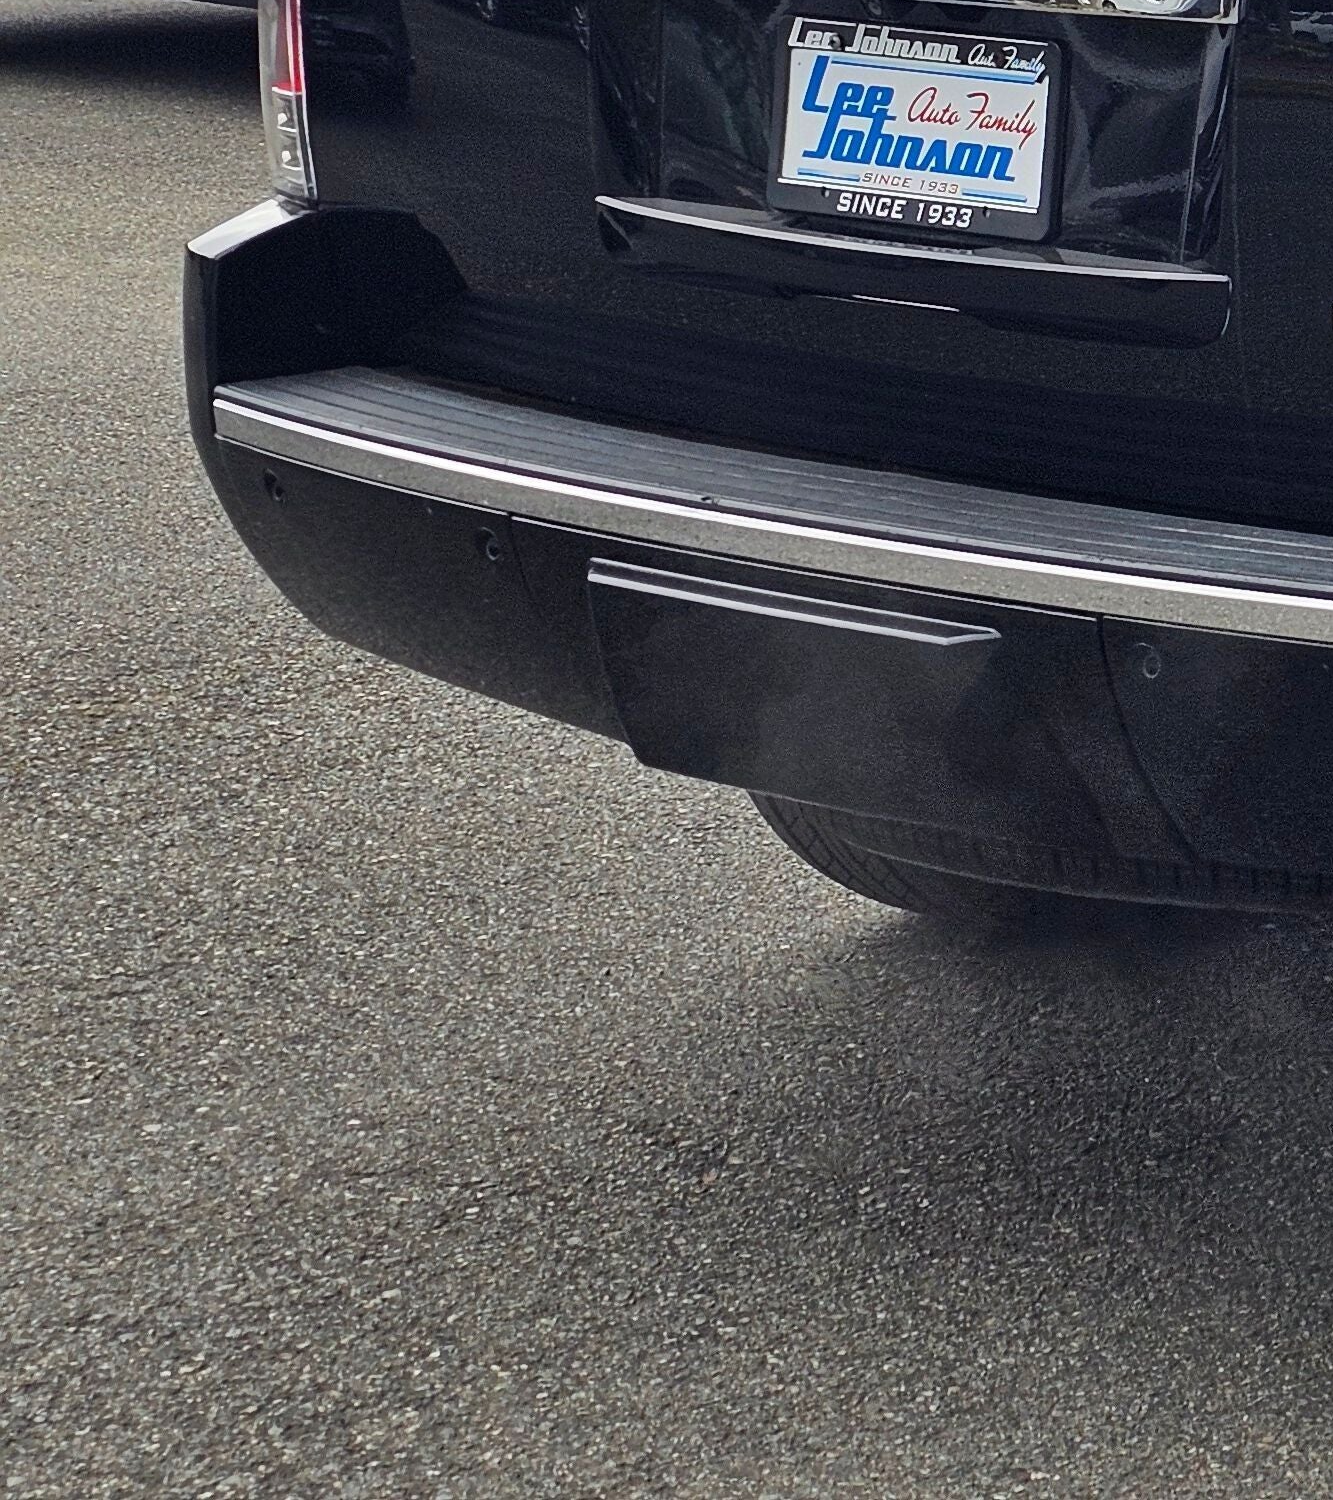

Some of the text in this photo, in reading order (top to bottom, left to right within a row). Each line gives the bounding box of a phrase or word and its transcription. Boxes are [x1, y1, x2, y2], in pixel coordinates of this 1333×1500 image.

[845, 23, 961, 63] Johnson
[1002, 45, 1046, 82] Family
[802, 55, 896, 121] Lee
[907, 86, 1037, 149] Auto Family
[802, 106, 1015, 182] Johnson
[836, 192, 973, 229] SINCE 1933
[861, 171, 959, 195] SINCE 1933
